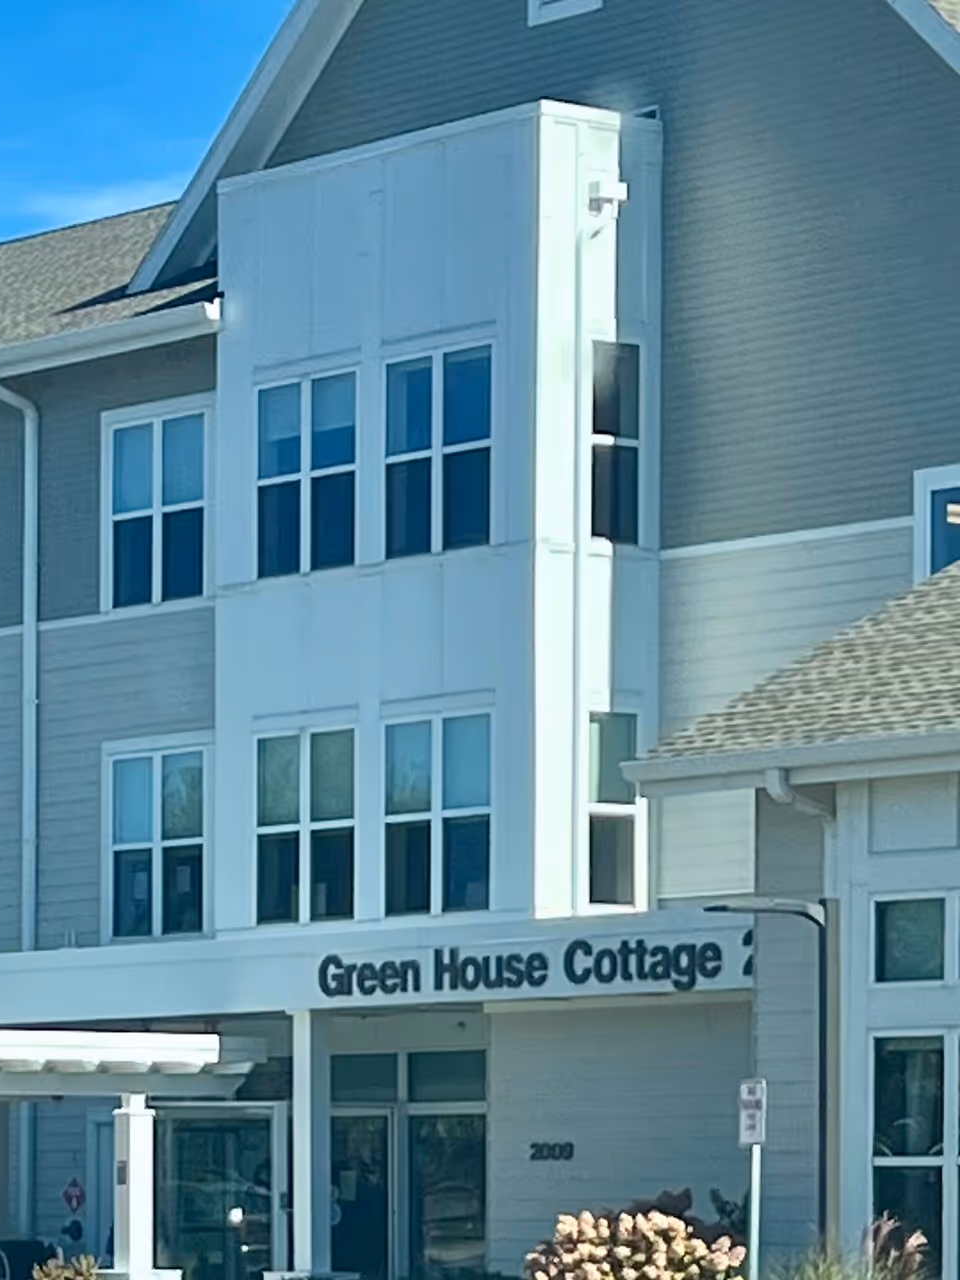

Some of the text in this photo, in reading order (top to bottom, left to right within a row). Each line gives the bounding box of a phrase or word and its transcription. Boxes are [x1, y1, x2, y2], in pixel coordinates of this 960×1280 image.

[318, 954, 421, 998] Green
[433, 947, 549, 991] House
[563, 938, 723, 991] Cottage
